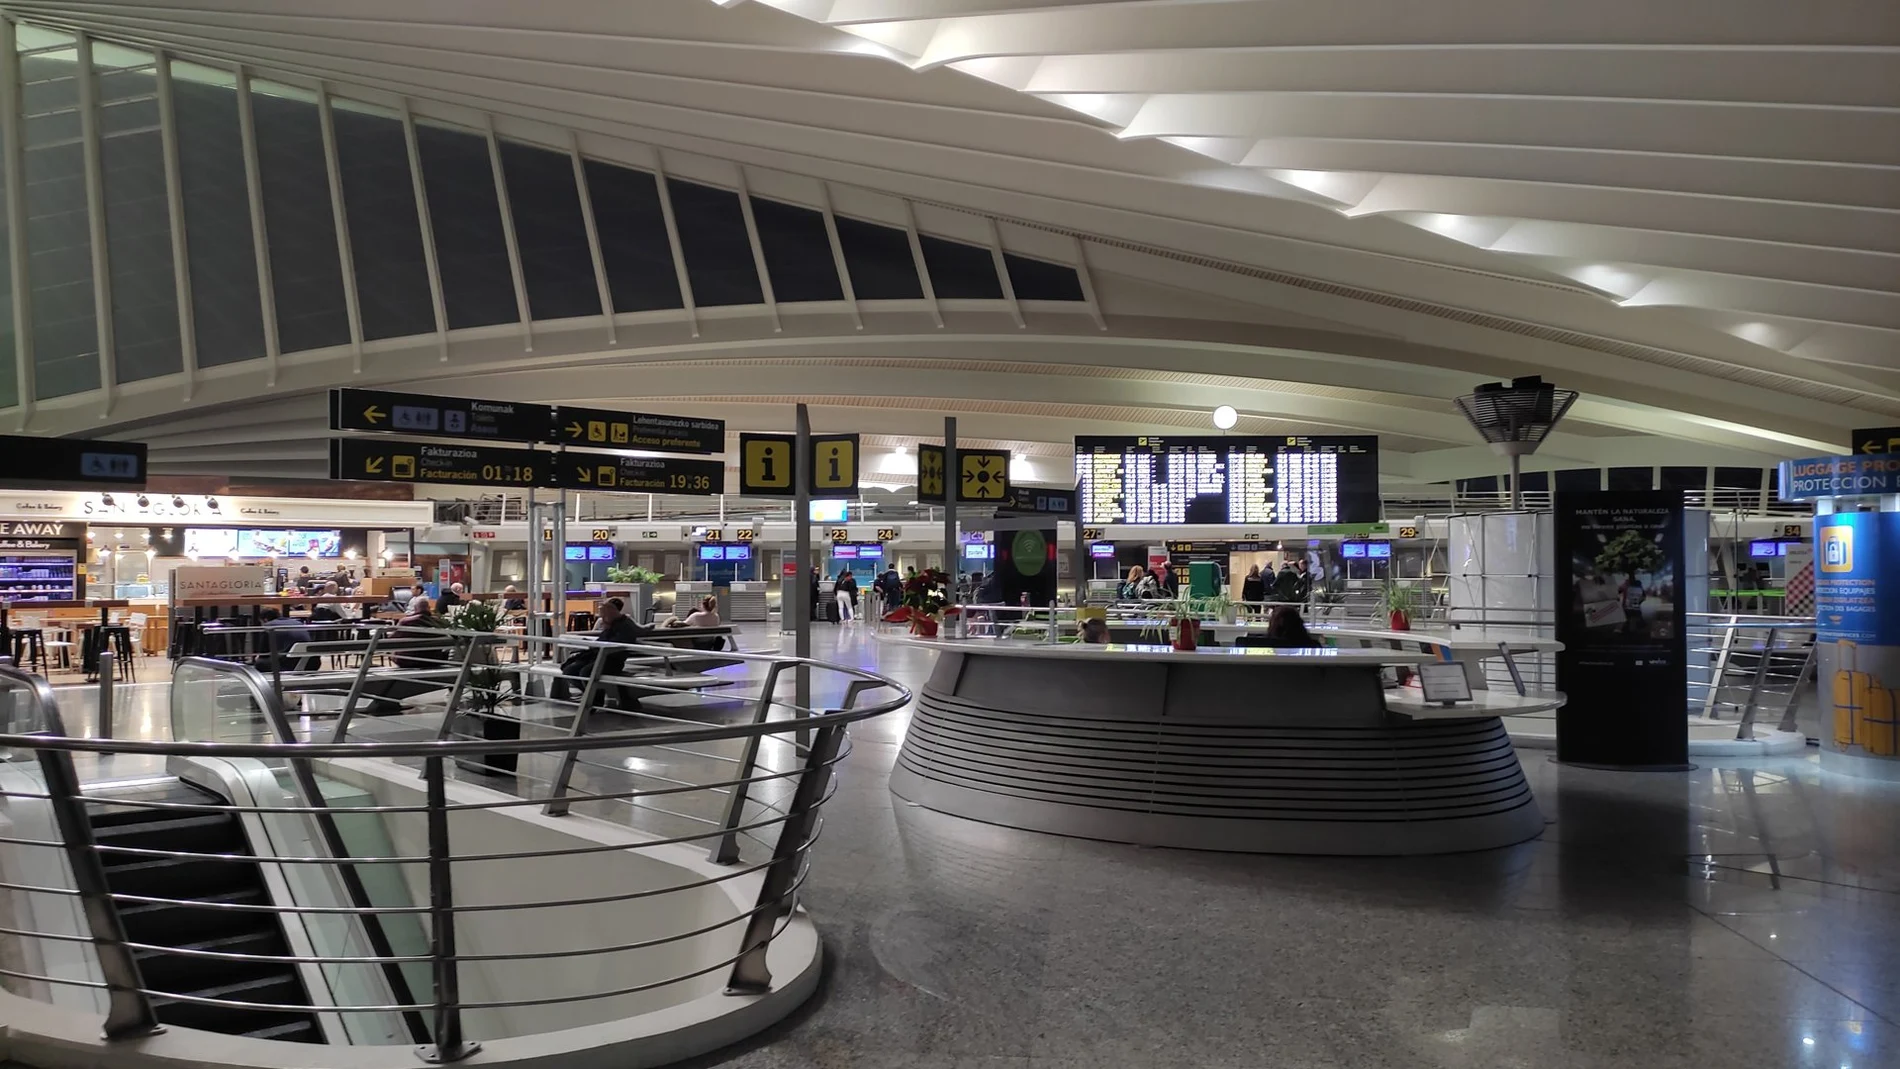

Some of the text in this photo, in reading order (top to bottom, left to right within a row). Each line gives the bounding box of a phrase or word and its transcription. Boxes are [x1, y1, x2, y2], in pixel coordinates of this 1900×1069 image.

[471, 402, 514, 414] Komunak
[691, 420, 719, 430] sarbidea
[632, 435, 701, 448] Acceso preferente
[420, 446, 478, 459] Fakturazioa
[620, 458, 666, 469] Fakturazioa
[1793, 460, 1857, 477] LUGGAGE
[420, 467, 478, 480] Facturación
[482, 465, 502, 481] 01
[513, 466, 533, 482] 18
[670, 474, 687, 489] 19
[693, 475, 710, 490] 36
[1793, 476, 1886, 492] PROTECCION
[12, 523, 64, 536] AWAY
[1083, 529, 1096, 539] 27
[1400, 527, 1415, 537] 29
[1786, 526, 1800, 536] 34
[593, 530, 609, 540] 20
[706, 530, 721, 540] 21
[738, 530, 753, 540] 22
[832, 530, 847, 540] 23
[878, 530, 893, 540] 24
[17, 540, 24, 548] &
[25, 540, 51, 550] Bakery
[180, 580, 262, 590] SANTAGLORIA
[1839, 587, 1876, 595] EQUIPAJES
